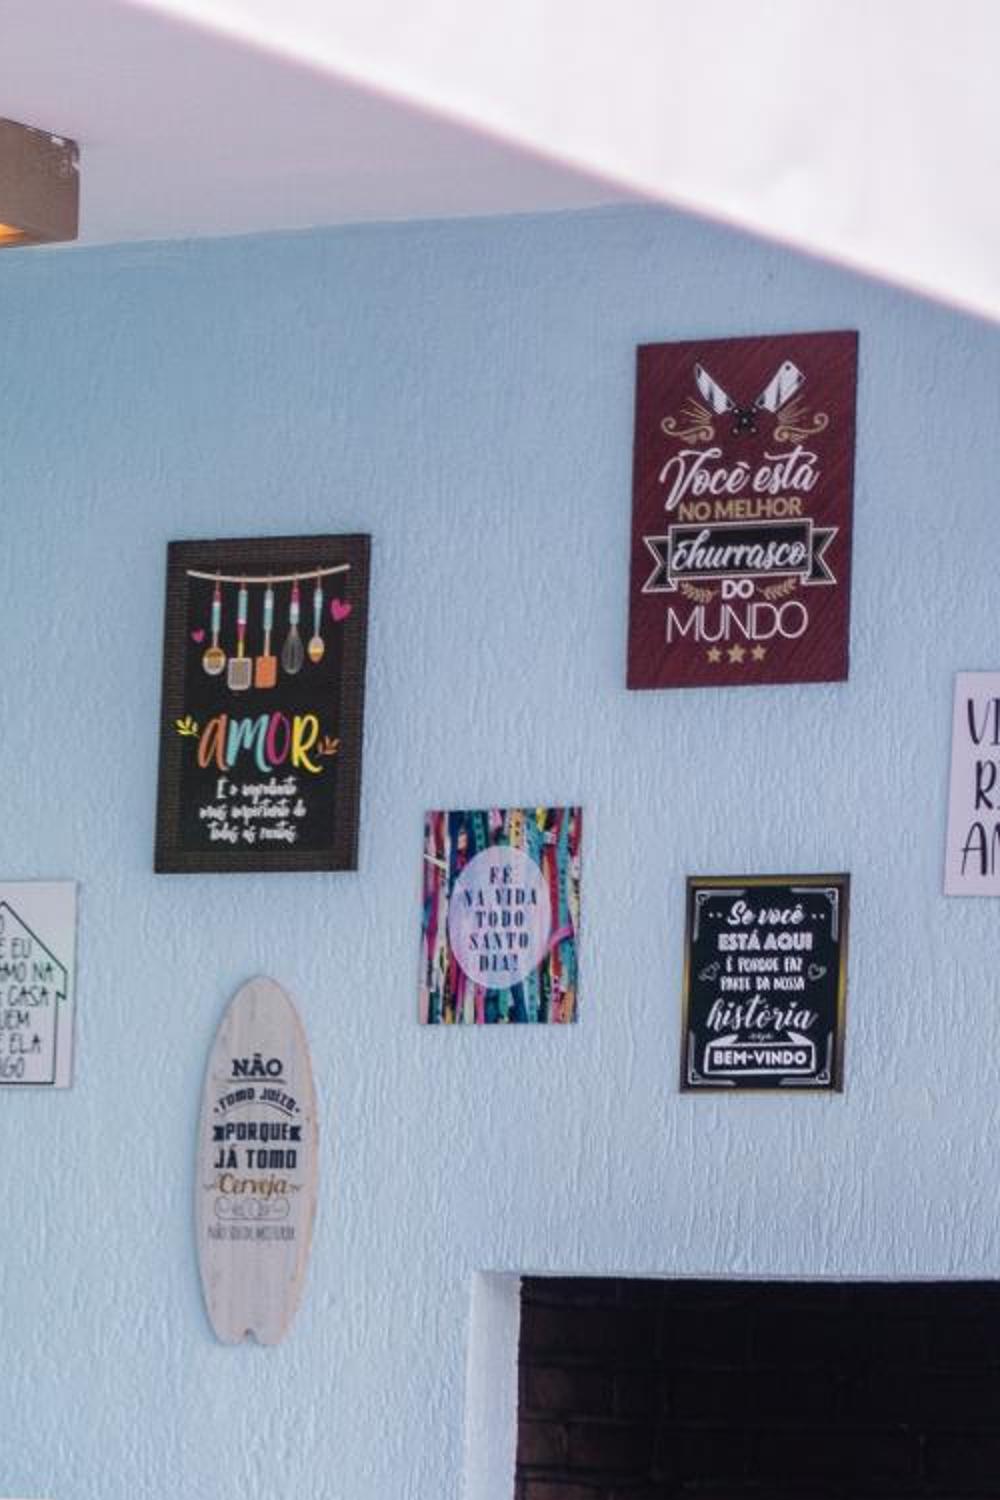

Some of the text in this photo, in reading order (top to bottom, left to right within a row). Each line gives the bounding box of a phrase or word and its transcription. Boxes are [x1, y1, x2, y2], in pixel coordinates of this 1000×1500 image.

[659, 447, 750, 511] Você
[677, 496, 803, 521] NO MELHOR
[721, 579, 755, 599] DO
[666, 601, 809, 643] MUNDO
[974, 760, 1000, 811] R
[464, 888, 538, 907] NA VIDA
[475, 910, 525, 929] TODO
[727, 899, 756, 925] Se
[10, 937, 33, 959] EU
[469, 931, 529, 950] SANTO
[717, 928, 814, 951] ESTÁ AQUI
[756, 975, 771, 991] DA
[7, 986, 50, 1007] CASA
[706, 993, 819, 1032] história
[9, 1032, 41, 1054] ELA
[231, 1053, 283, 1077] NÃO
[713, 1049, 808, 1066] BEM-VINDO
[219, 1087, 256, 1111] TOMO
[225, 1122, 289, 1143] PORQUE
[214, 1144, 298, 1170] JÁ TOMO
